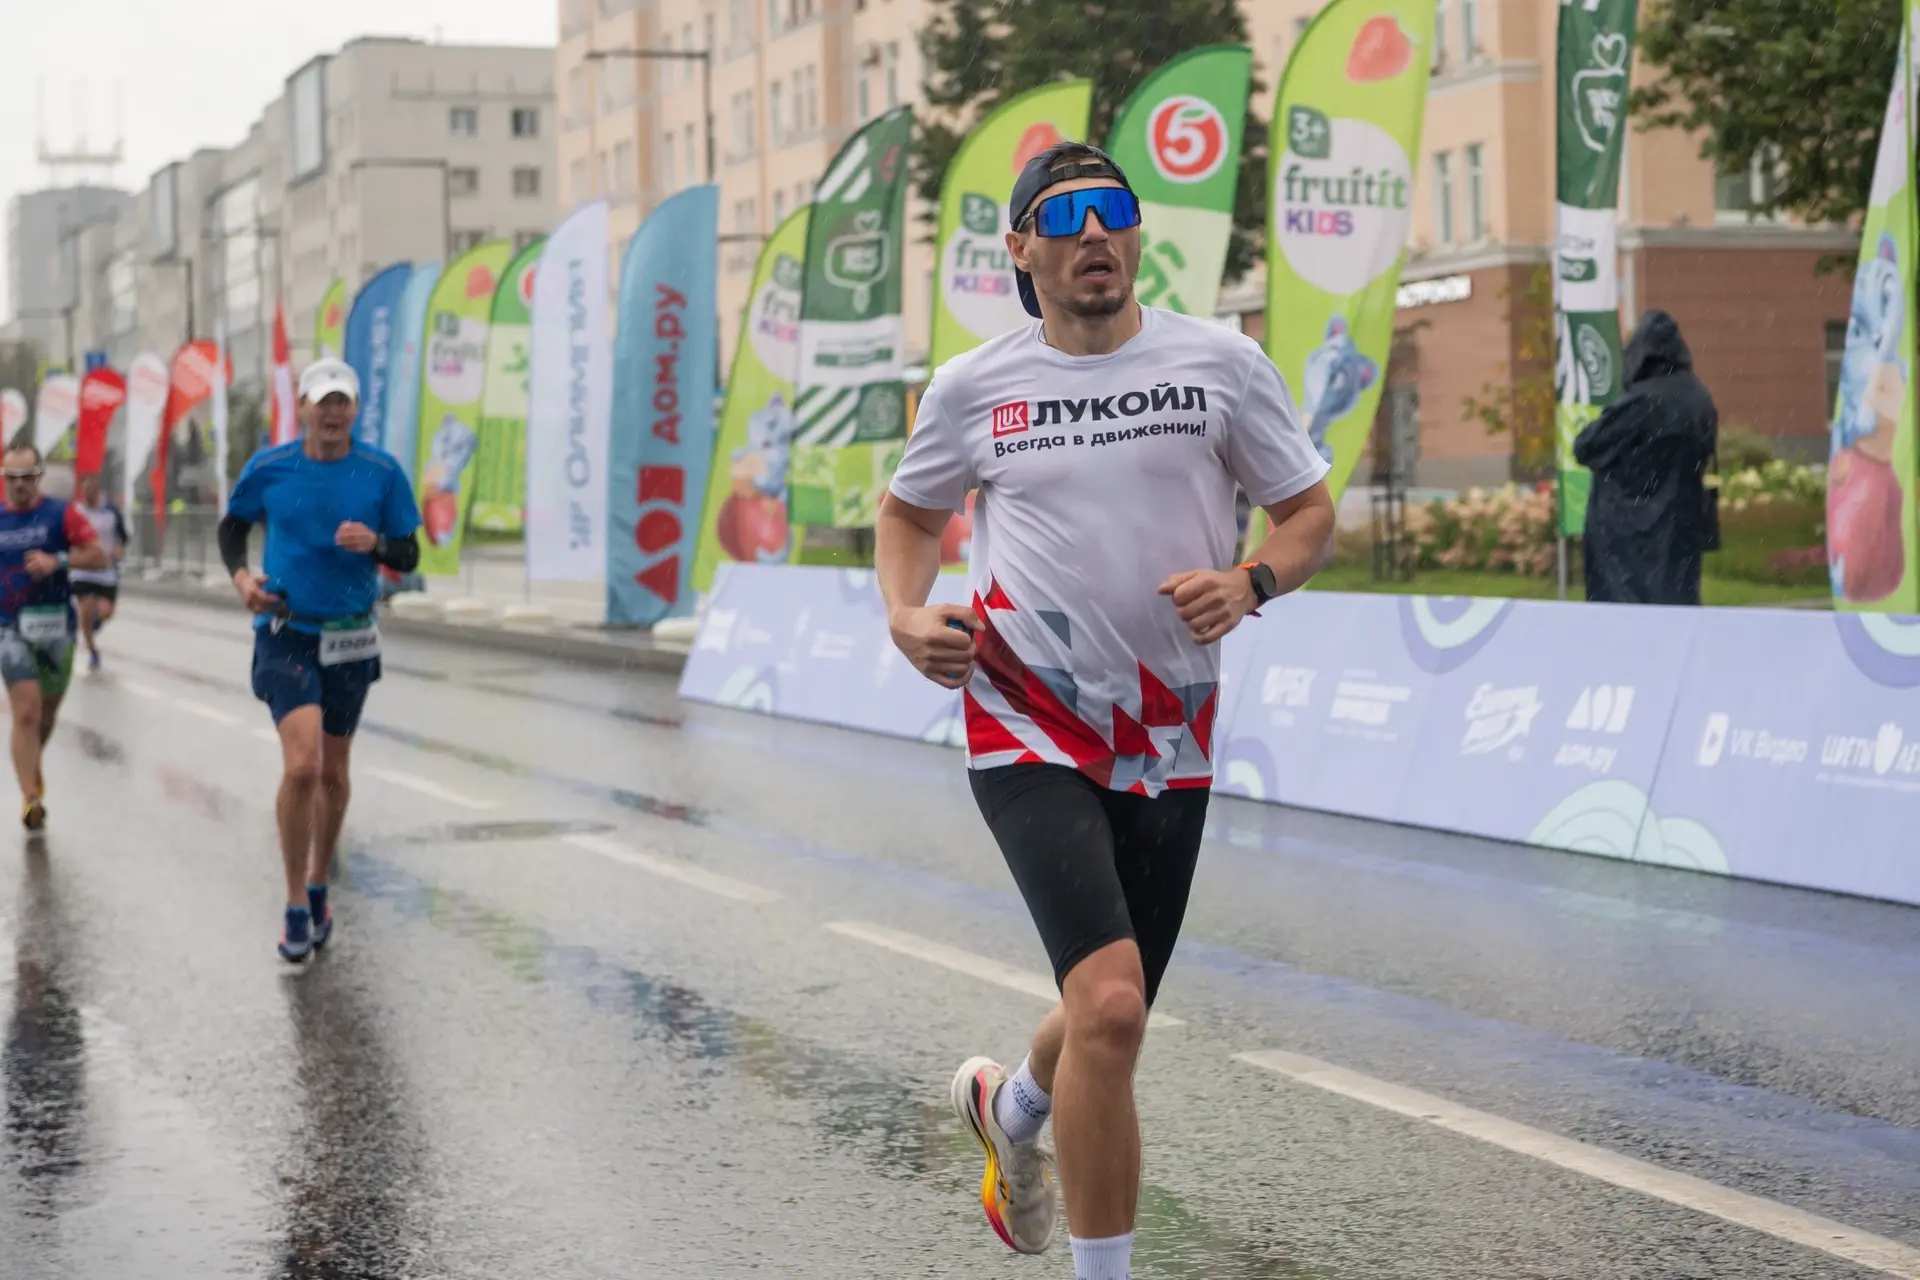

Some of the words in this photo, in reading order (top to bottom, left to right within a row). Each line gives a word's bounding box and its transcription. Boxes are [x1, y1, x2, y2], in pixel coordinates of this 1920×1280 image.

[1163, 101, 1207, 165] 5
[1292, 111, 1326, 141] 3+
[1285, 163, 1406, 209] fruitit
[1286, 209, 1354, 236] KIDS
[953, 275, 1012, 296] KIDS
[1032, 382, 1207, 427] ЛУКОЙЛ
[994, 435, 1066, 458] Всегда
[1073, 434, 1085, 446] в
[1090, 420, 1207, 447] движении!
